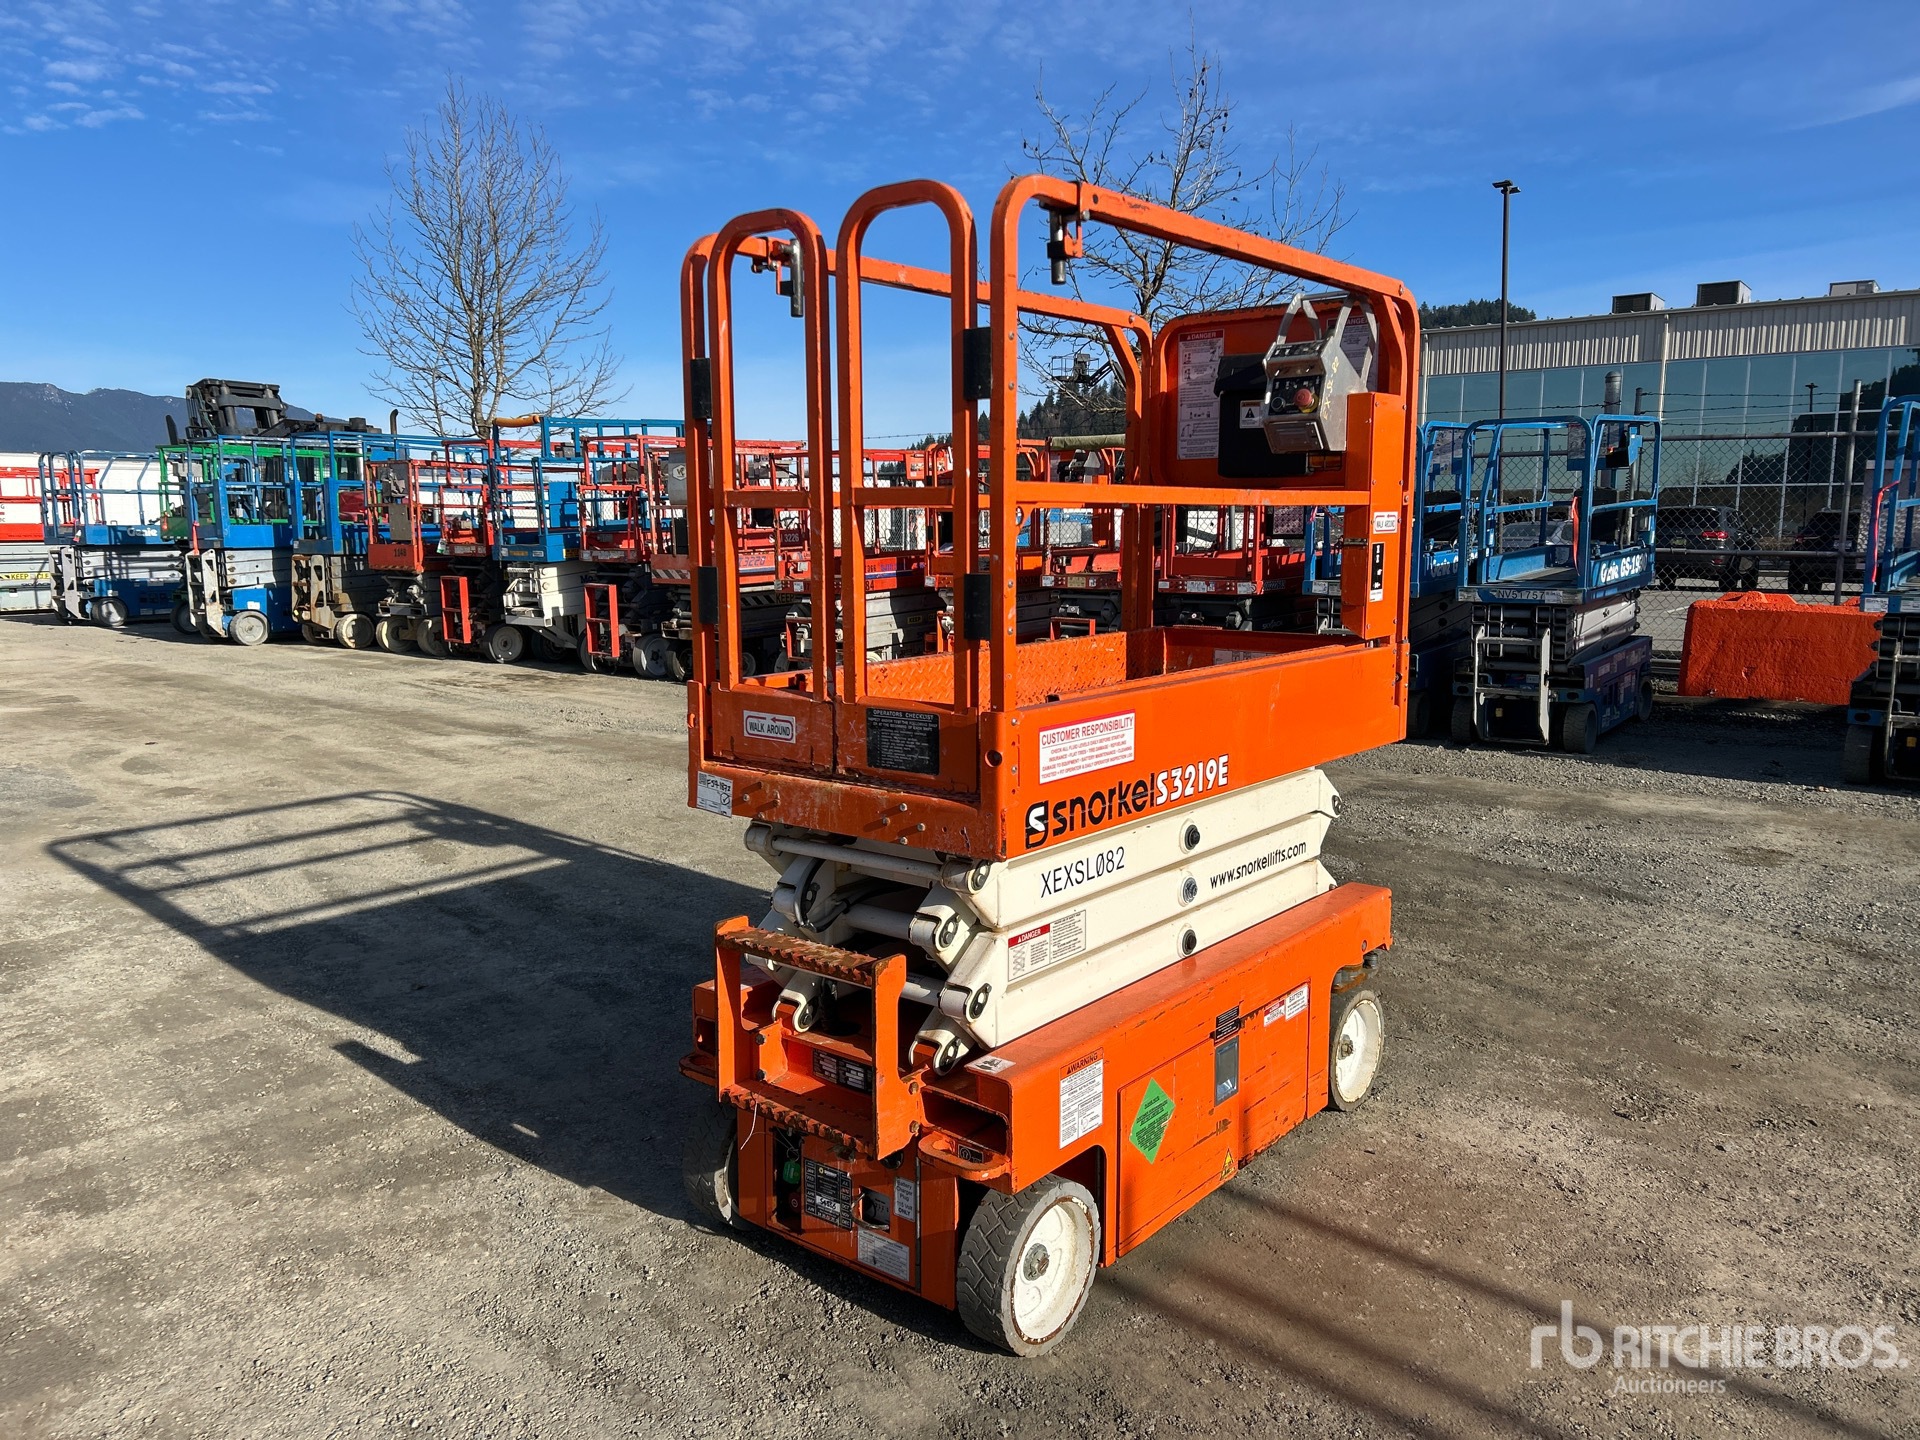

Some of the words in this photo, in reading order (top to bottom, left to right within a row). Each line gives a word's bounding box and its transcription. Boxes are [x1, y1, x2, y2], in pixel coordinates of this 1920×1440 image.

[1191, 331, 1217, 340] DANGER
[749, 722, 764, 732] WALK
[766, 724, 790, 736] AROUND
[1042, 728, 1080, 746] CUSTOMER
[1082, 716, 1133, 737] RESPONSIBILITY
[1053, 773, 1155, 837] snorkel
[1156, 754, 1229, 806] S3219E
[1210, 841, 1307, 890] www.snorkellifts.com
[1021, 928, 1042, 942] DANGER
[1070, 1052, 1098, 1072] WARNING
